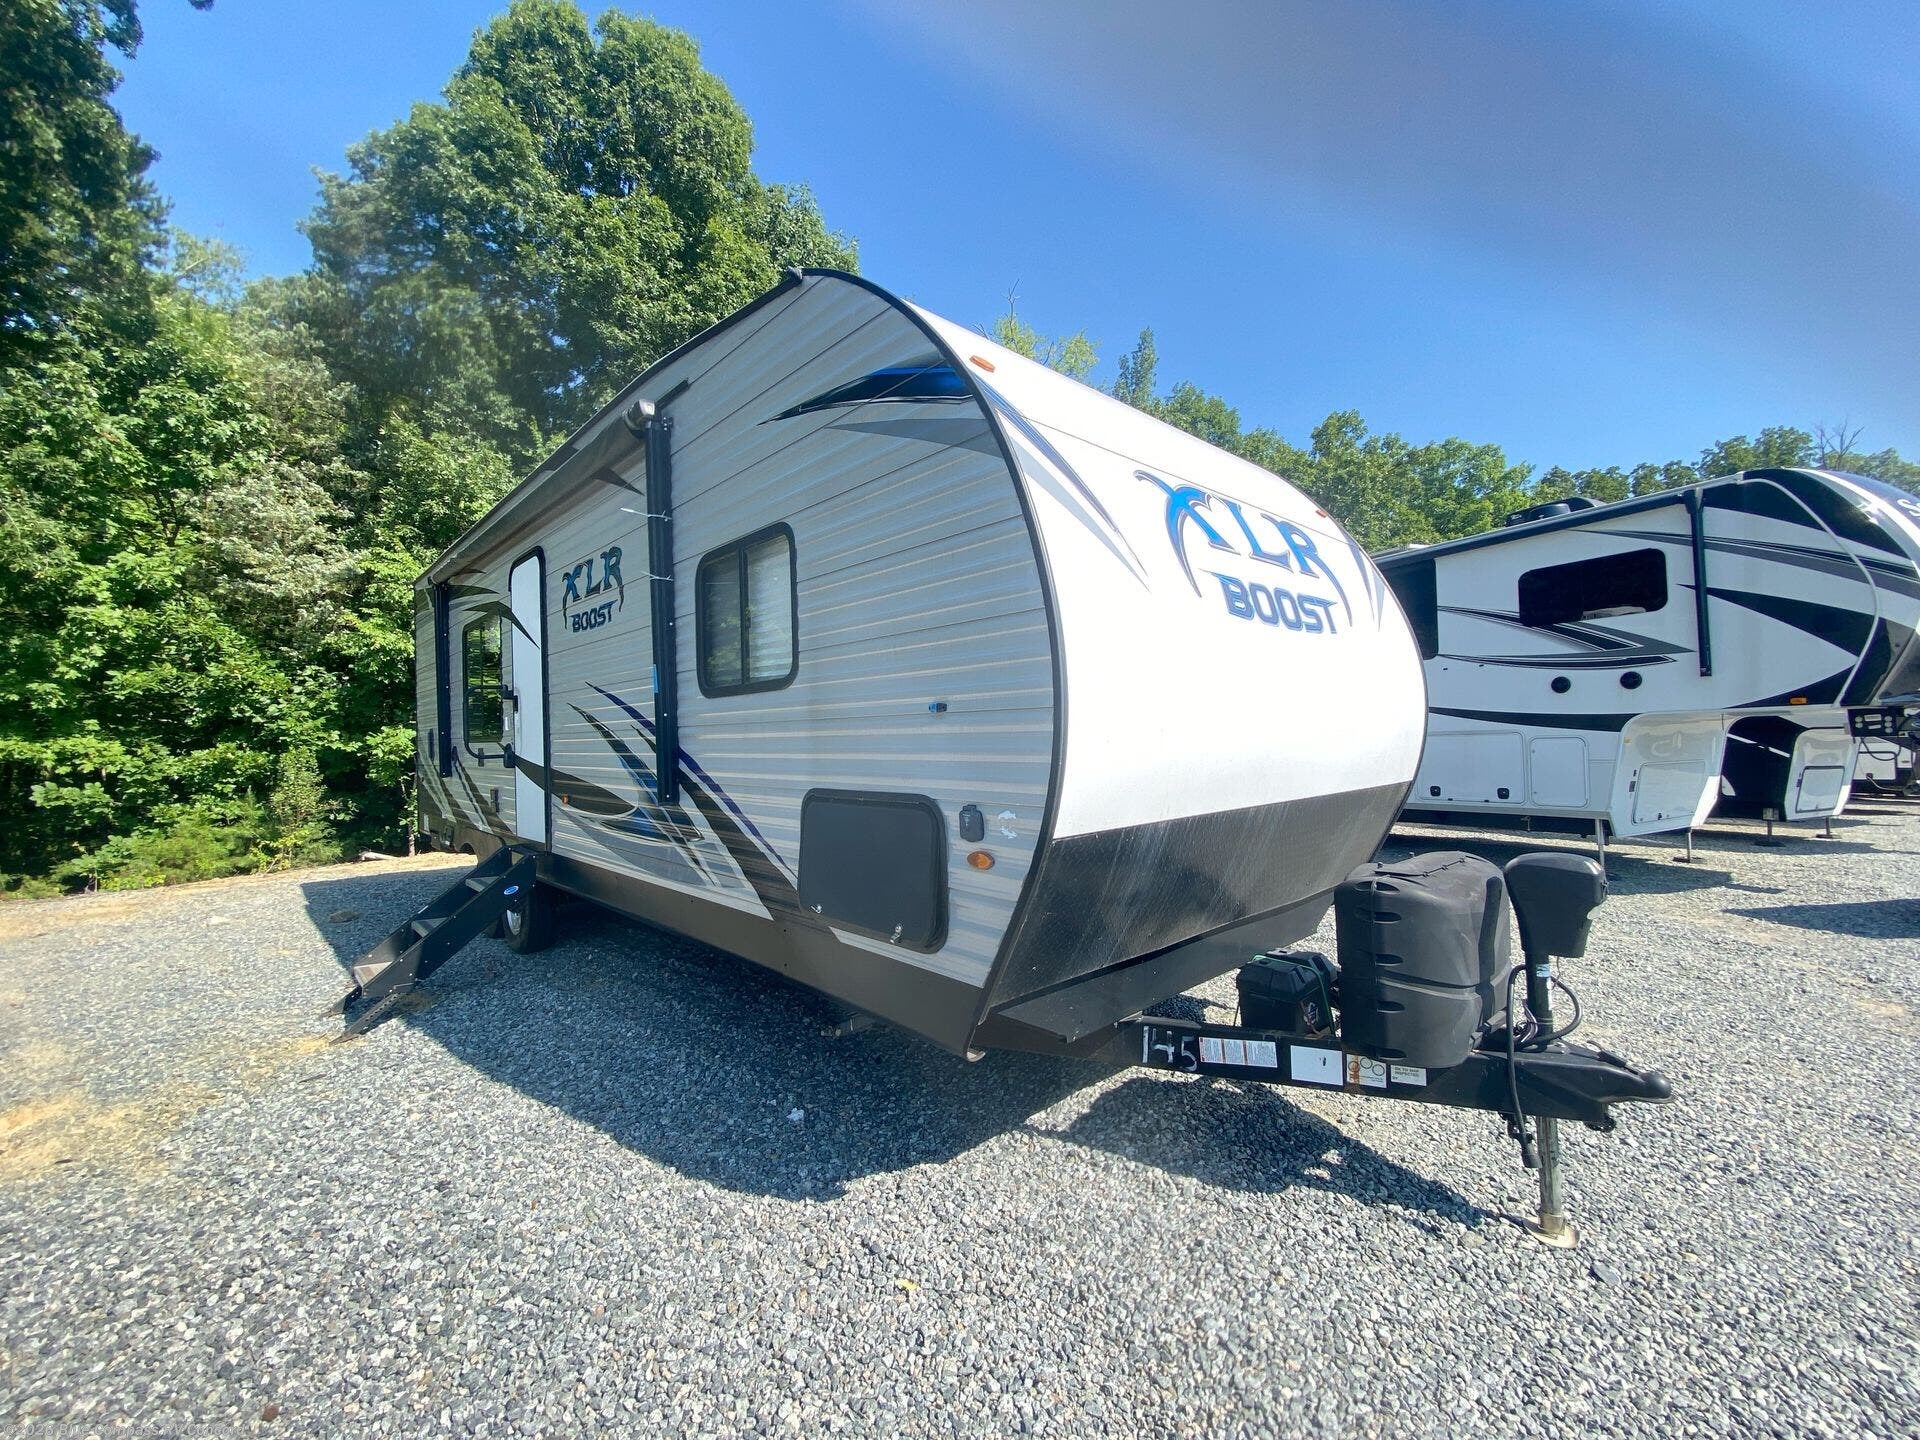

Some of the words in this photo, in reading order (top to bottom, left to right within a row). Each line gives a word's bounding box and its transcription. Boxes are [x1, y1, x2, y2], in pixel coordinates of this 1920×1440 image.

[1133, 469, 1352, 627] XLR
[562, 546, 624, 630] XLR
[569, 599, 618, 633] BOOST
[1200, 568, 1338, 635] BOOST
